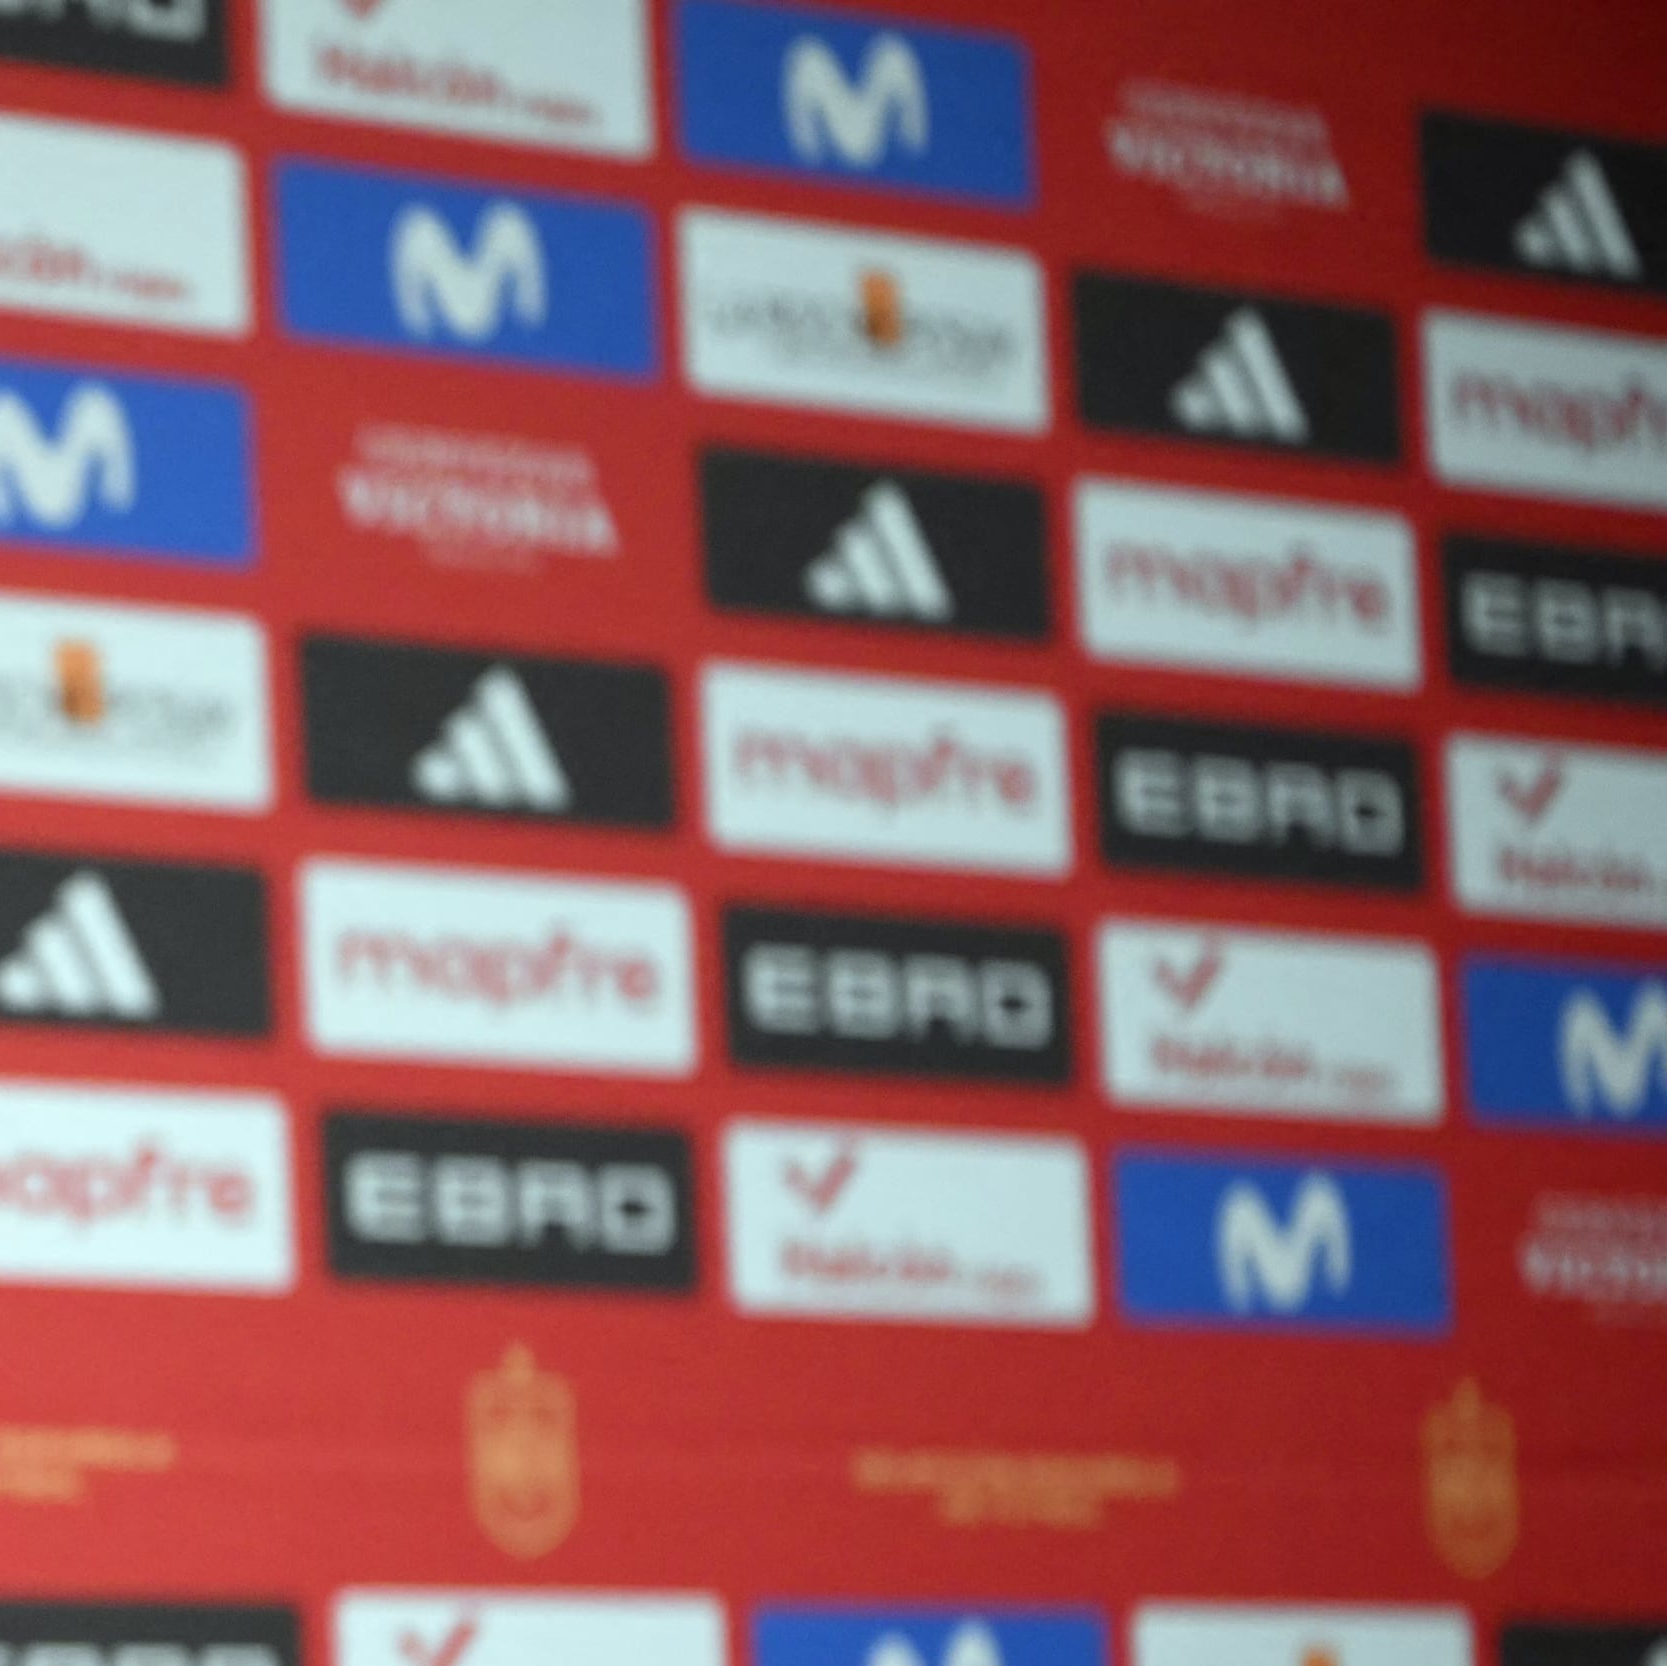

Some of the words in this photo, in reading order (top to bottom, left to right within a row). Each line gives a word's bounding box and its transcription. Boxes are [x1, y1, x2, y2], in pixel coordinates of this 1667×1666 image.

[1107, 548, 1393, 633] mapfre
[1462, 574, 1667, 660] EBR
[736, 733, 1039, 814] mapfre
[1115, 751, 1402, 851] EBRO
[337, 928, 661, 1008] mapfre
[744, 946, 1050, 1045] EBRO
[345, 1154, 674, 1251] EBRO
